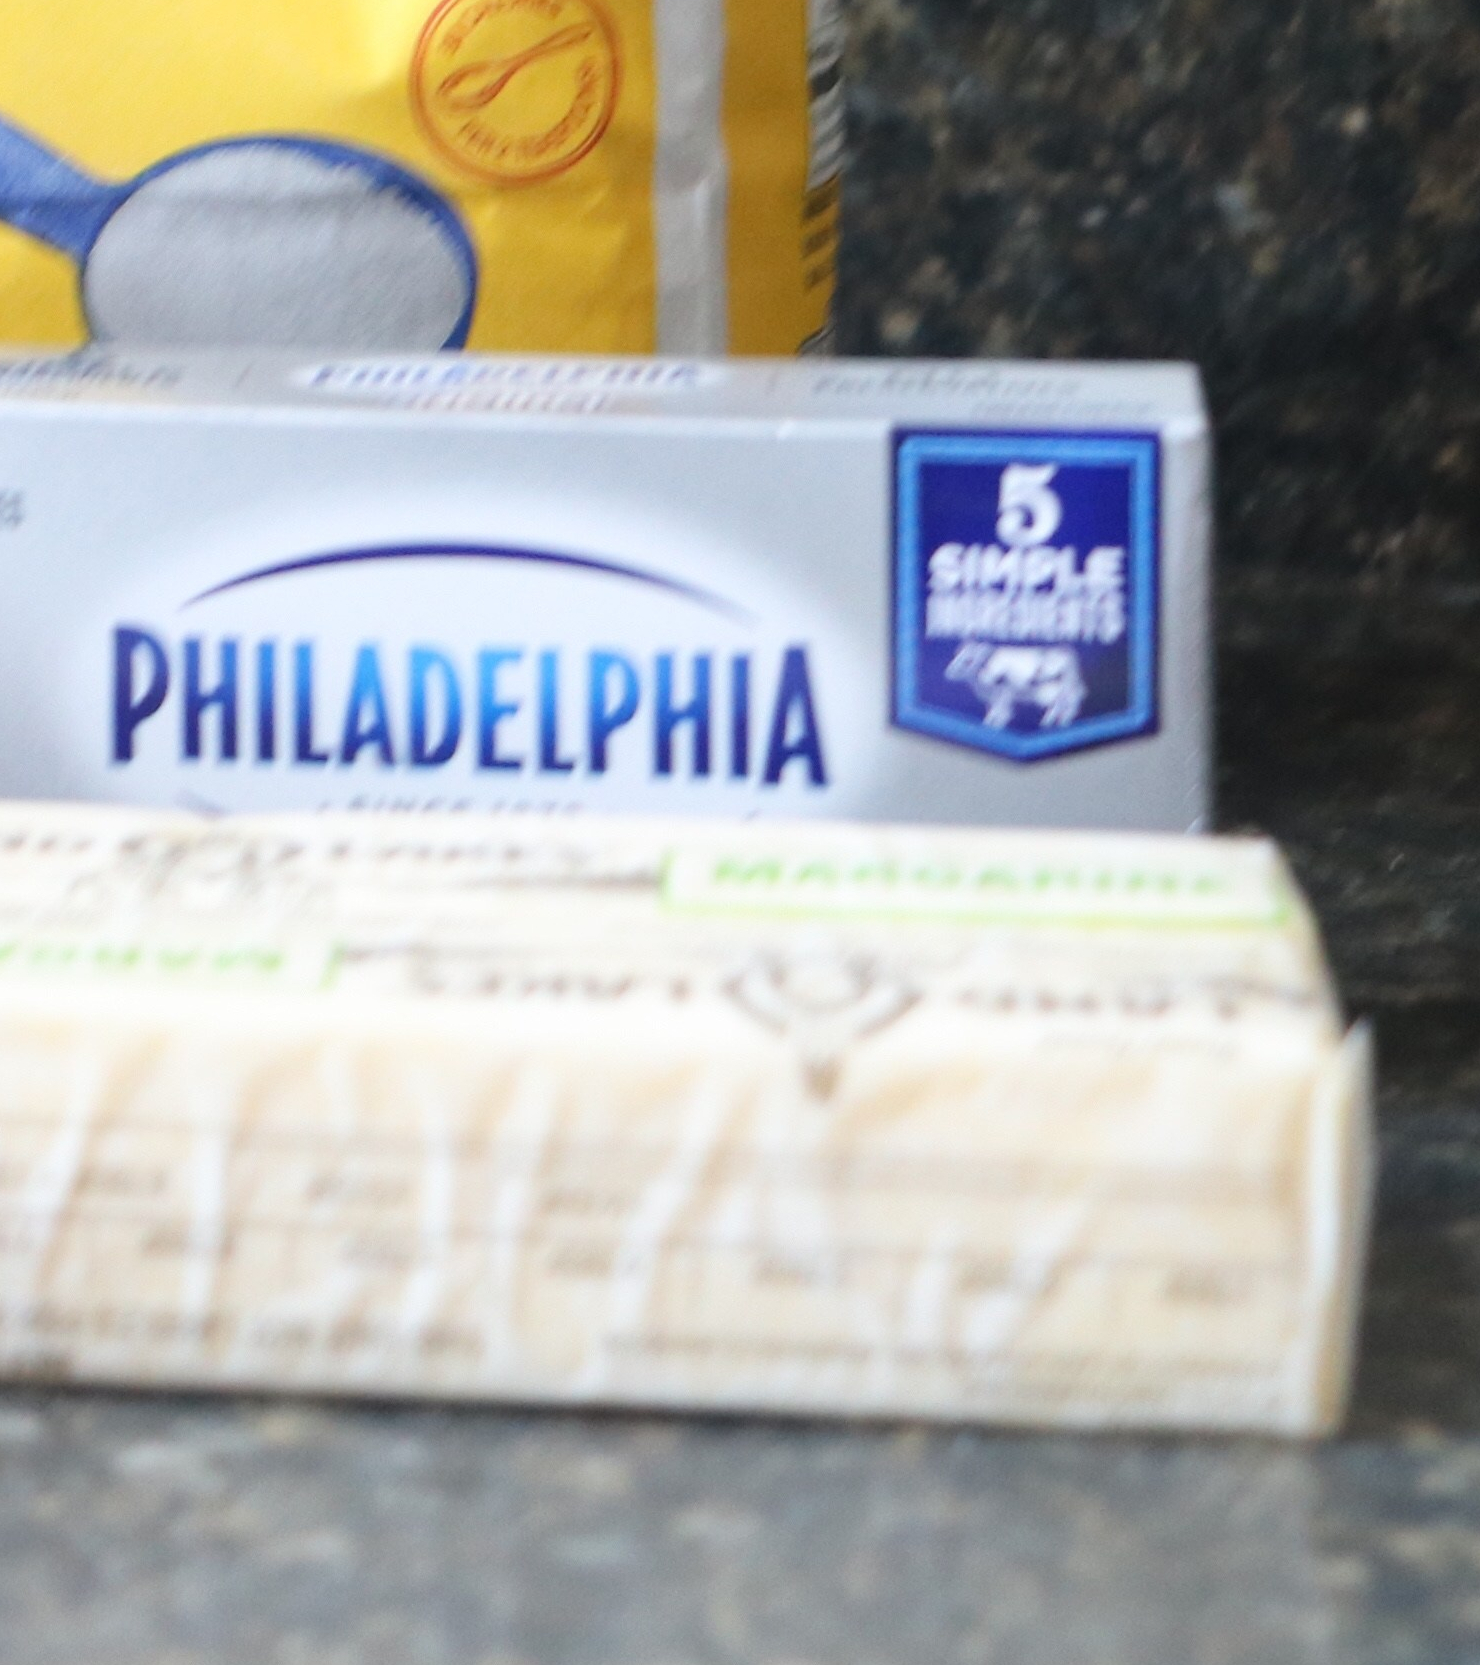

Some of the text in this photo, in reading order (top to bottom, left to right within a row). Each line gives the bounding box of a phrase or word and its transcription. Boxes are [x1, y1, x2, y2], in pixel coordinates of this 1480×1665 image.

[995, 461, 1064, 548] 5
[926, 542, 1126, 592] SIMPLE
[107, 618, 831, 789] PHILADELPHIA
